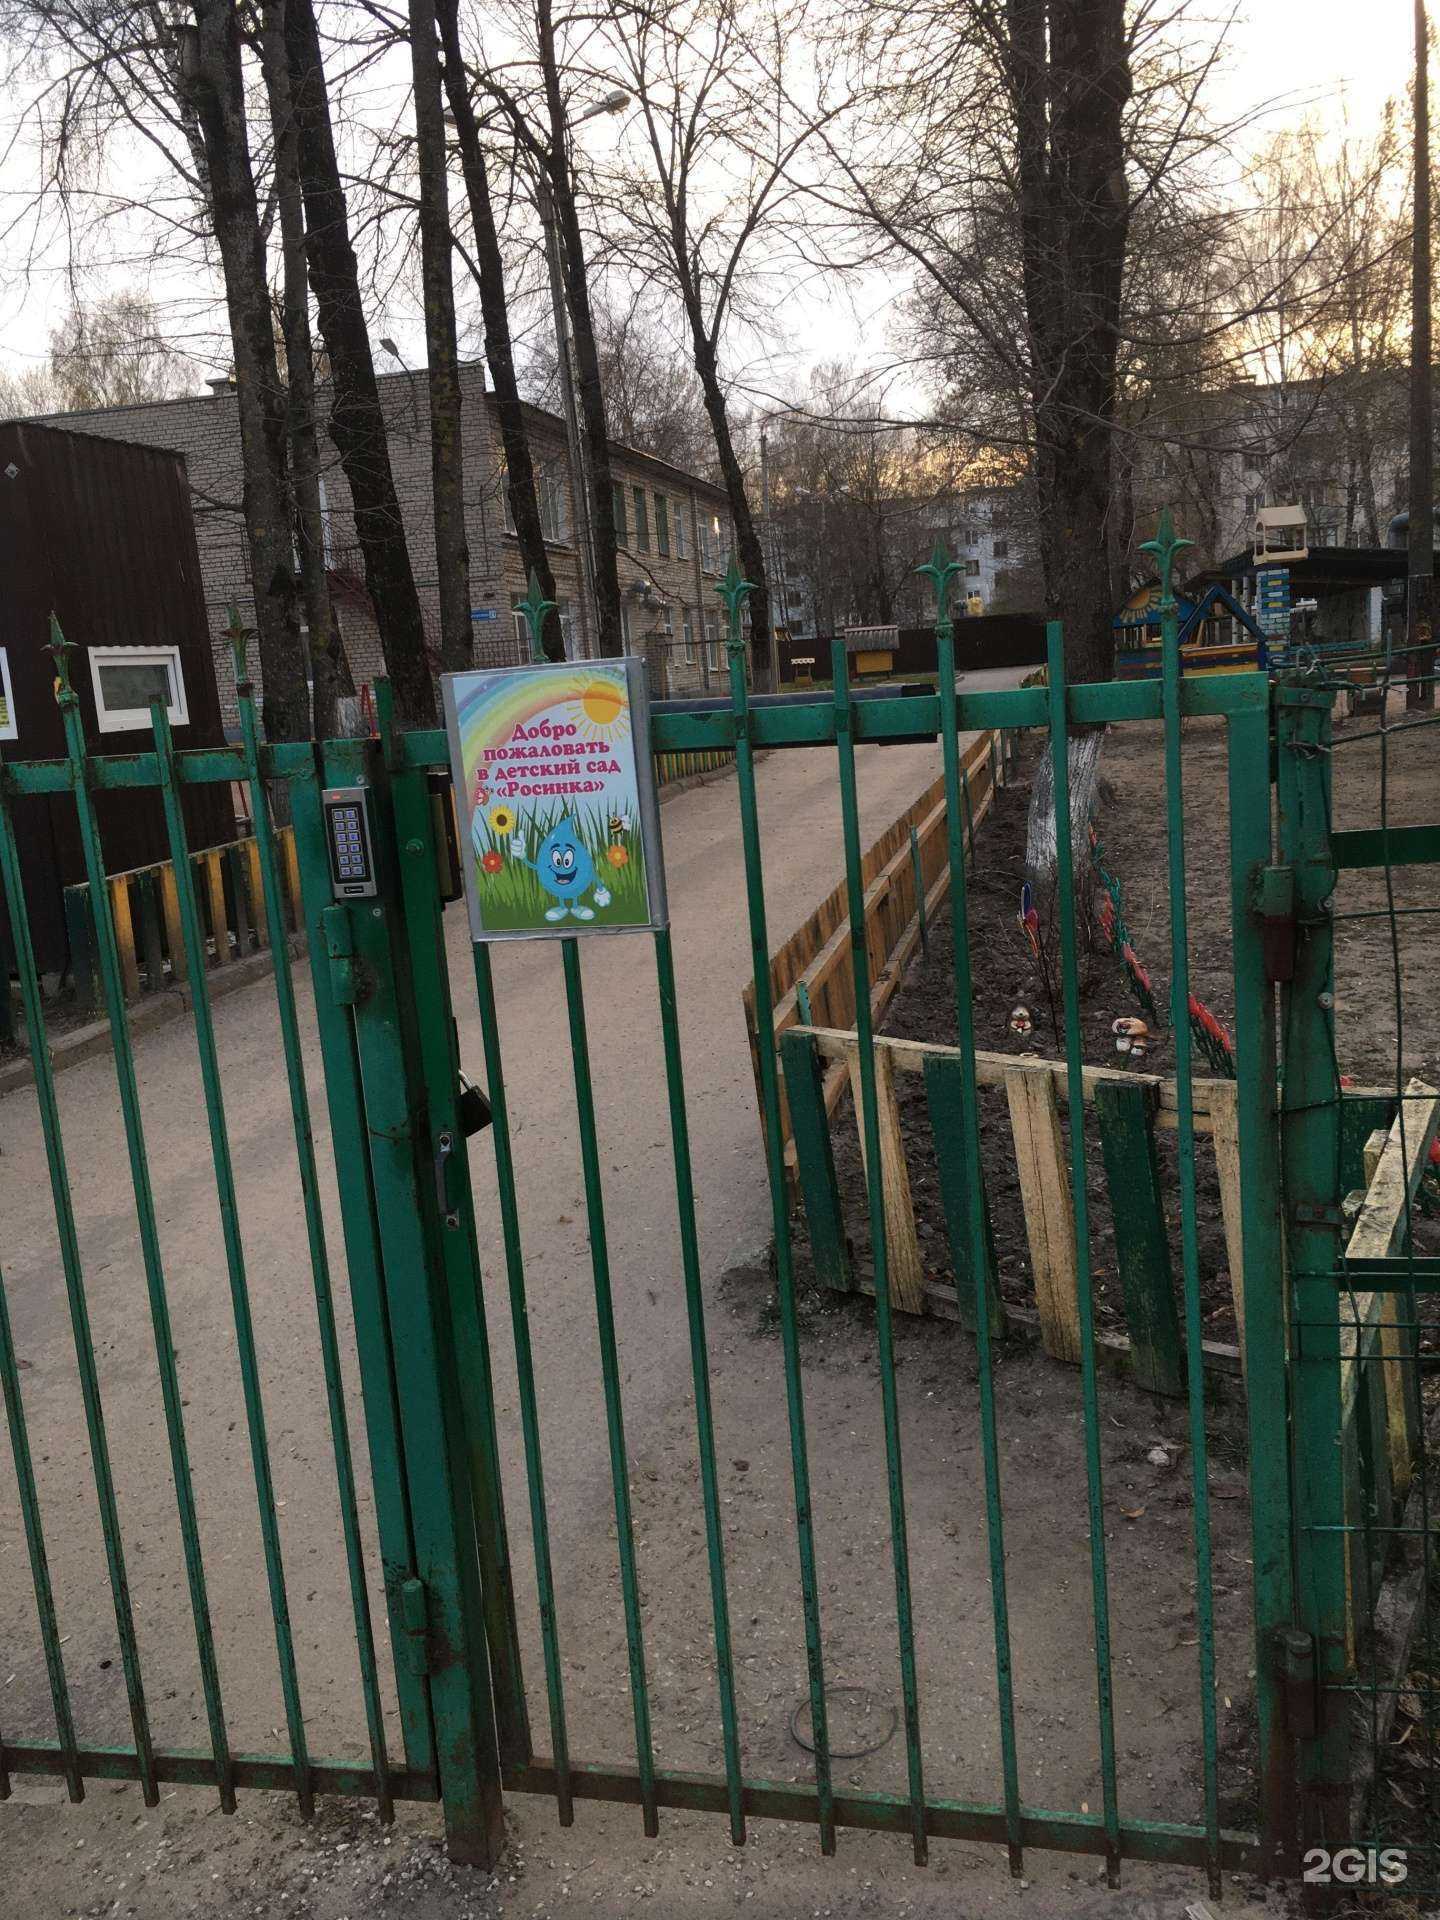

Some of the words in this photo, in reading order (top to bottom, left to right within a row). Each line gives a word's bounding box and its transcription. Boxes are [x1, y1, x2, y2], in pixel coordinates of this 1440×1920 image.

[512, 719, 577, 742] Добро
[484, 741, 610, 761] пожаловать
[477, 768, 490, 781] в
[495, 758, 582, 781] детский
[586, 760, 622, 774] сад
[496, 780, 606, 798] «Росинка»
